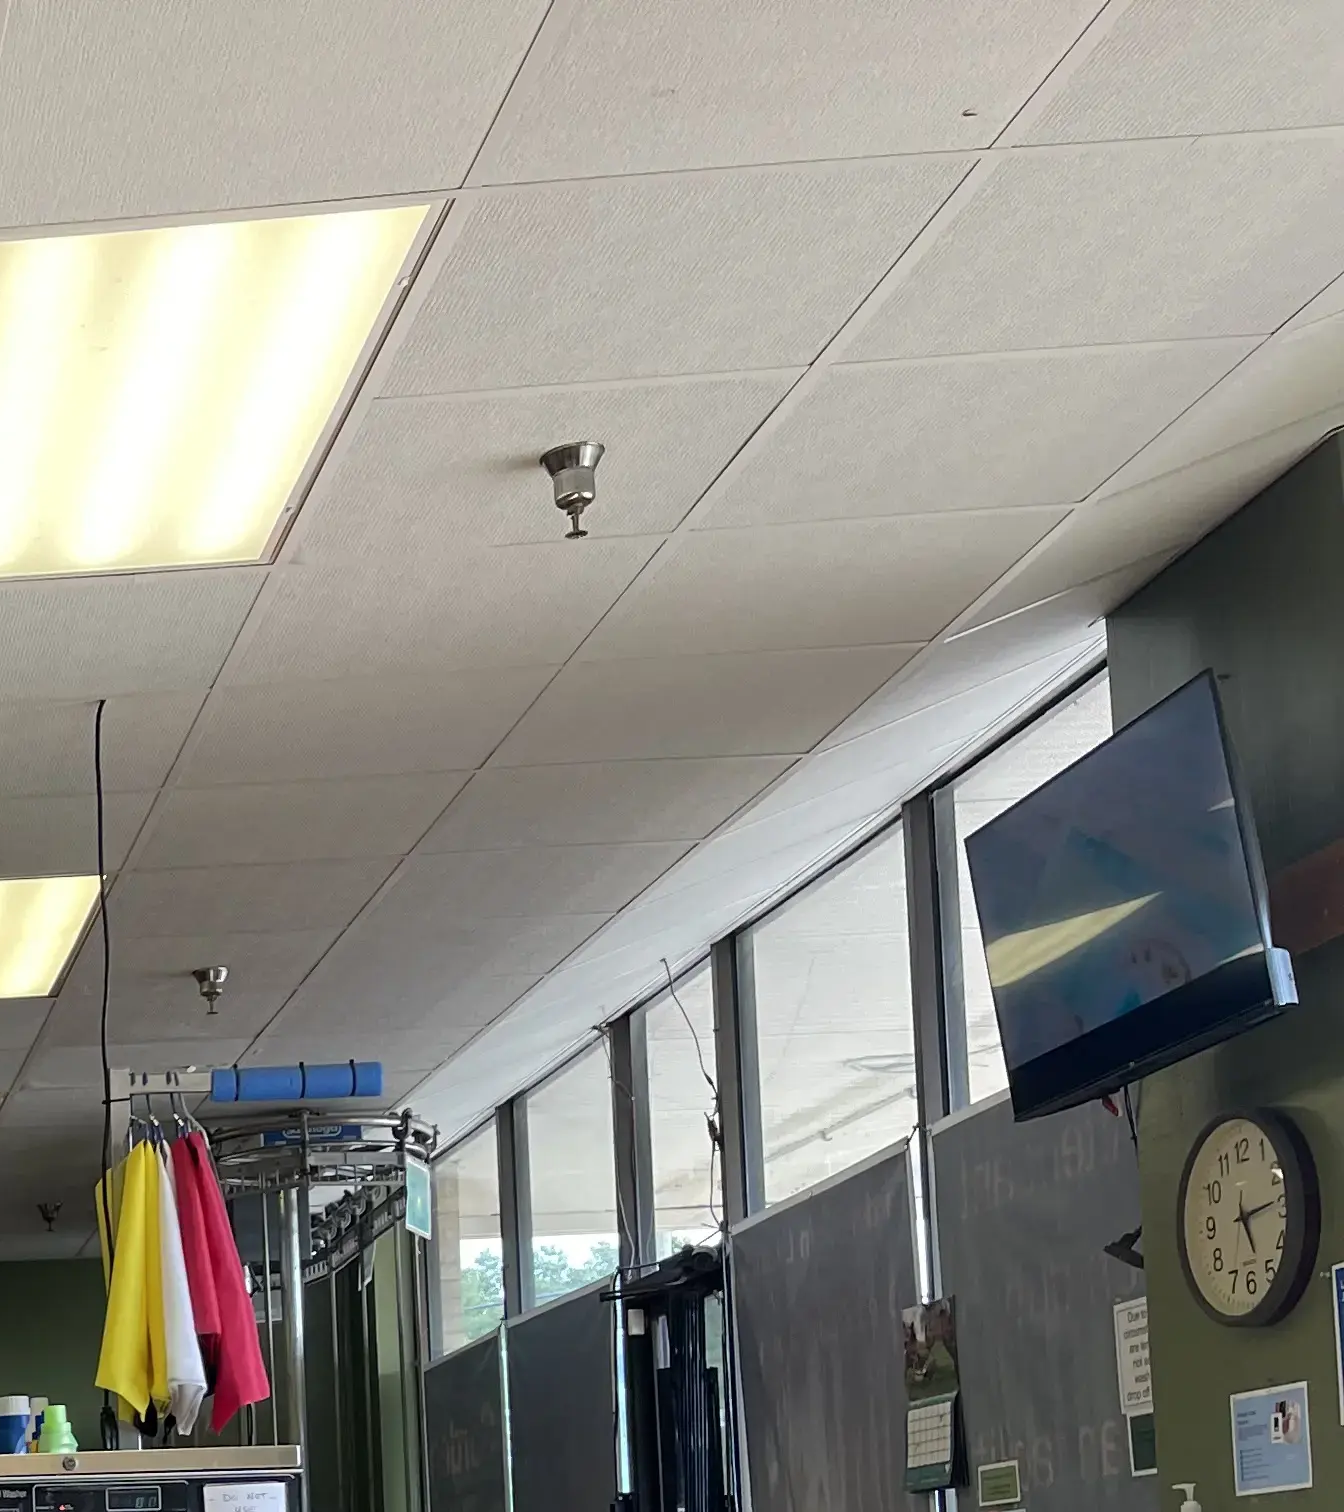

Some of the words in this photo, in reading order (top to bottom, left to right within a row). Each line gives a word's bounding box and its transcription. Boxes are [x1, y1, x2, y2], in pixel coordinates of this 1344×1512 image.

[1234, 1138, 1250, 1164] 12
[1259, 1138, 1266, 1161] 1
[1217, 1152, 1230, 1177] 11
[1204, 1180, 1221, 1205] 10
[1277, 1194, 1287, 1218] 3
[1206, 1216, 1216, 1240] 9
[1276, 1230, 1285, 1250] 4
[1213, 1248, 1224, 1272] 8
[1265, 1259, 1277, 1283] 5
[1228, 1269, 1239, 1294] 7
[1246, 1270, 1257, 1295] 6
